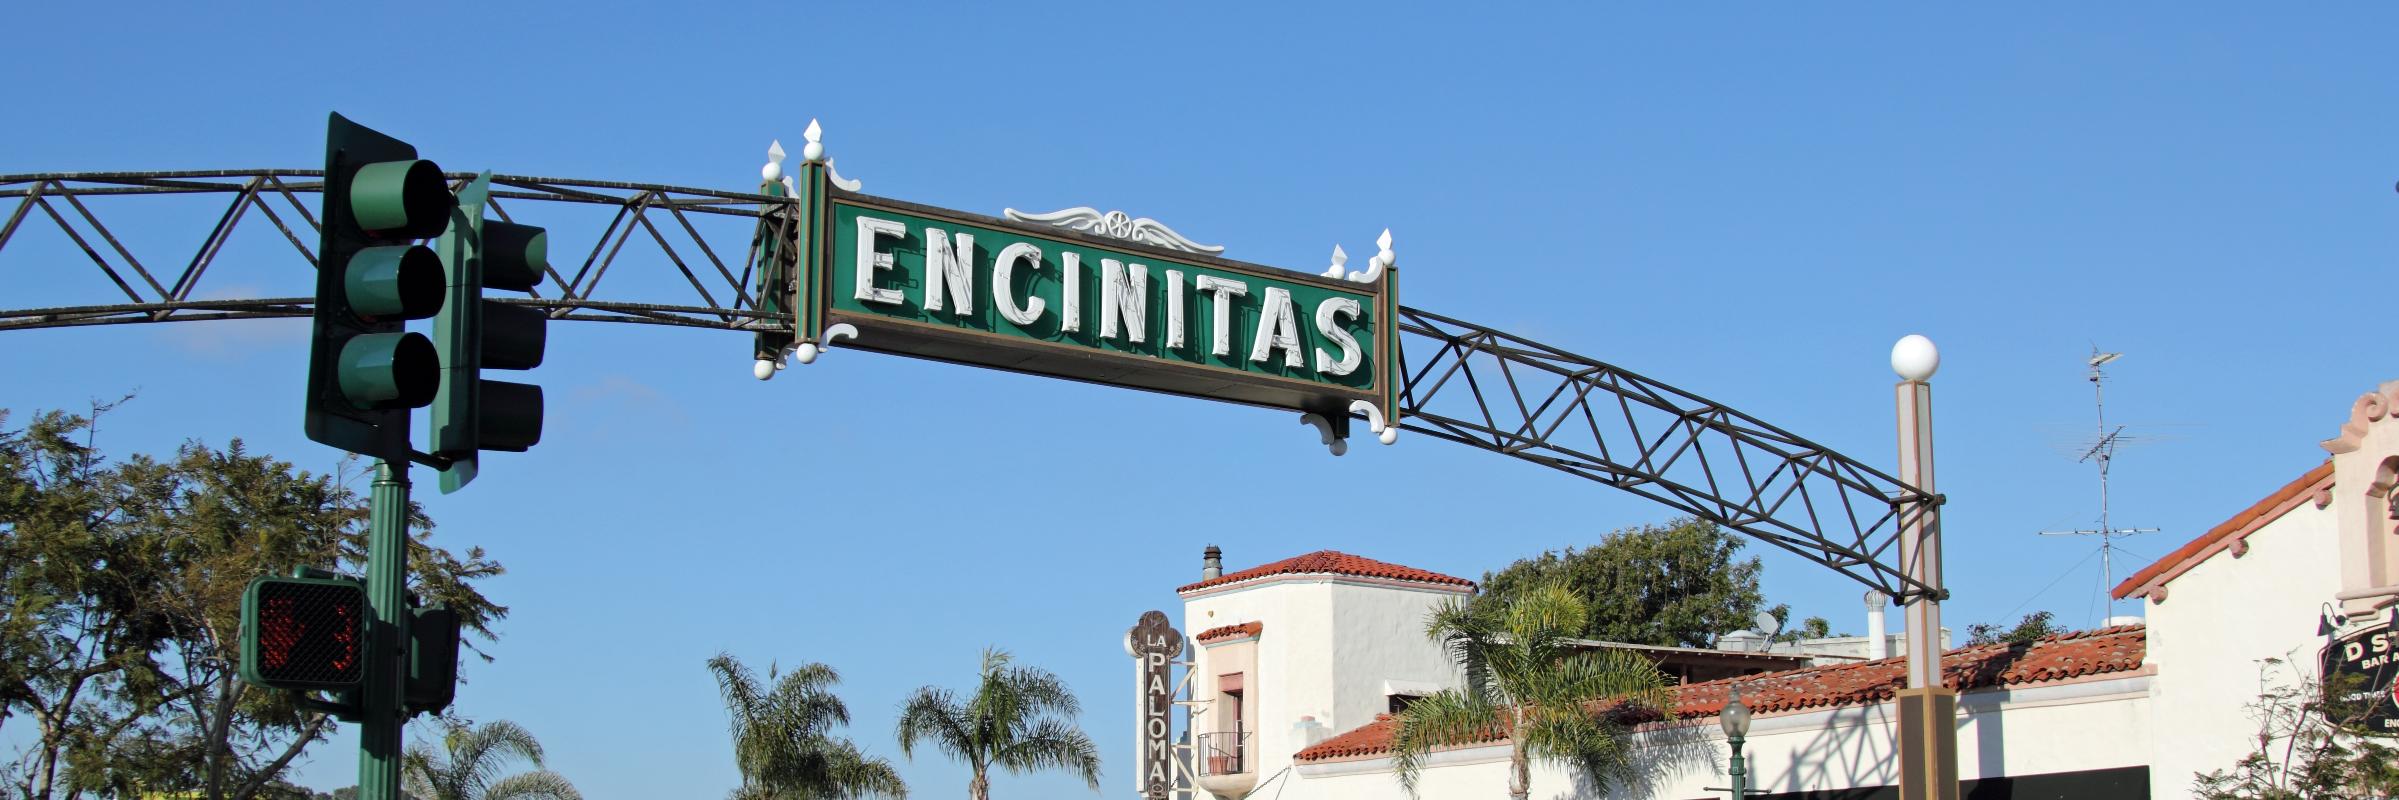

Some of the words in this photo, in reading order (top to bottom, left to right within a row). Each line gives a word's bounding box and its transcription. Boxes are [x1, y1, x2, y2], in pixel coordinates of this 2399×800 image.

[854, 216, 1362, 376] ENCINITAS
[1147, 634, 1167, 648] LA
[2344, 642, 2363, 662] D
[2362, 655, 2389, 670] BAR
[2363, 690, 2385, 699] TES
[1148, 652, 1167, 782] PALOMA
